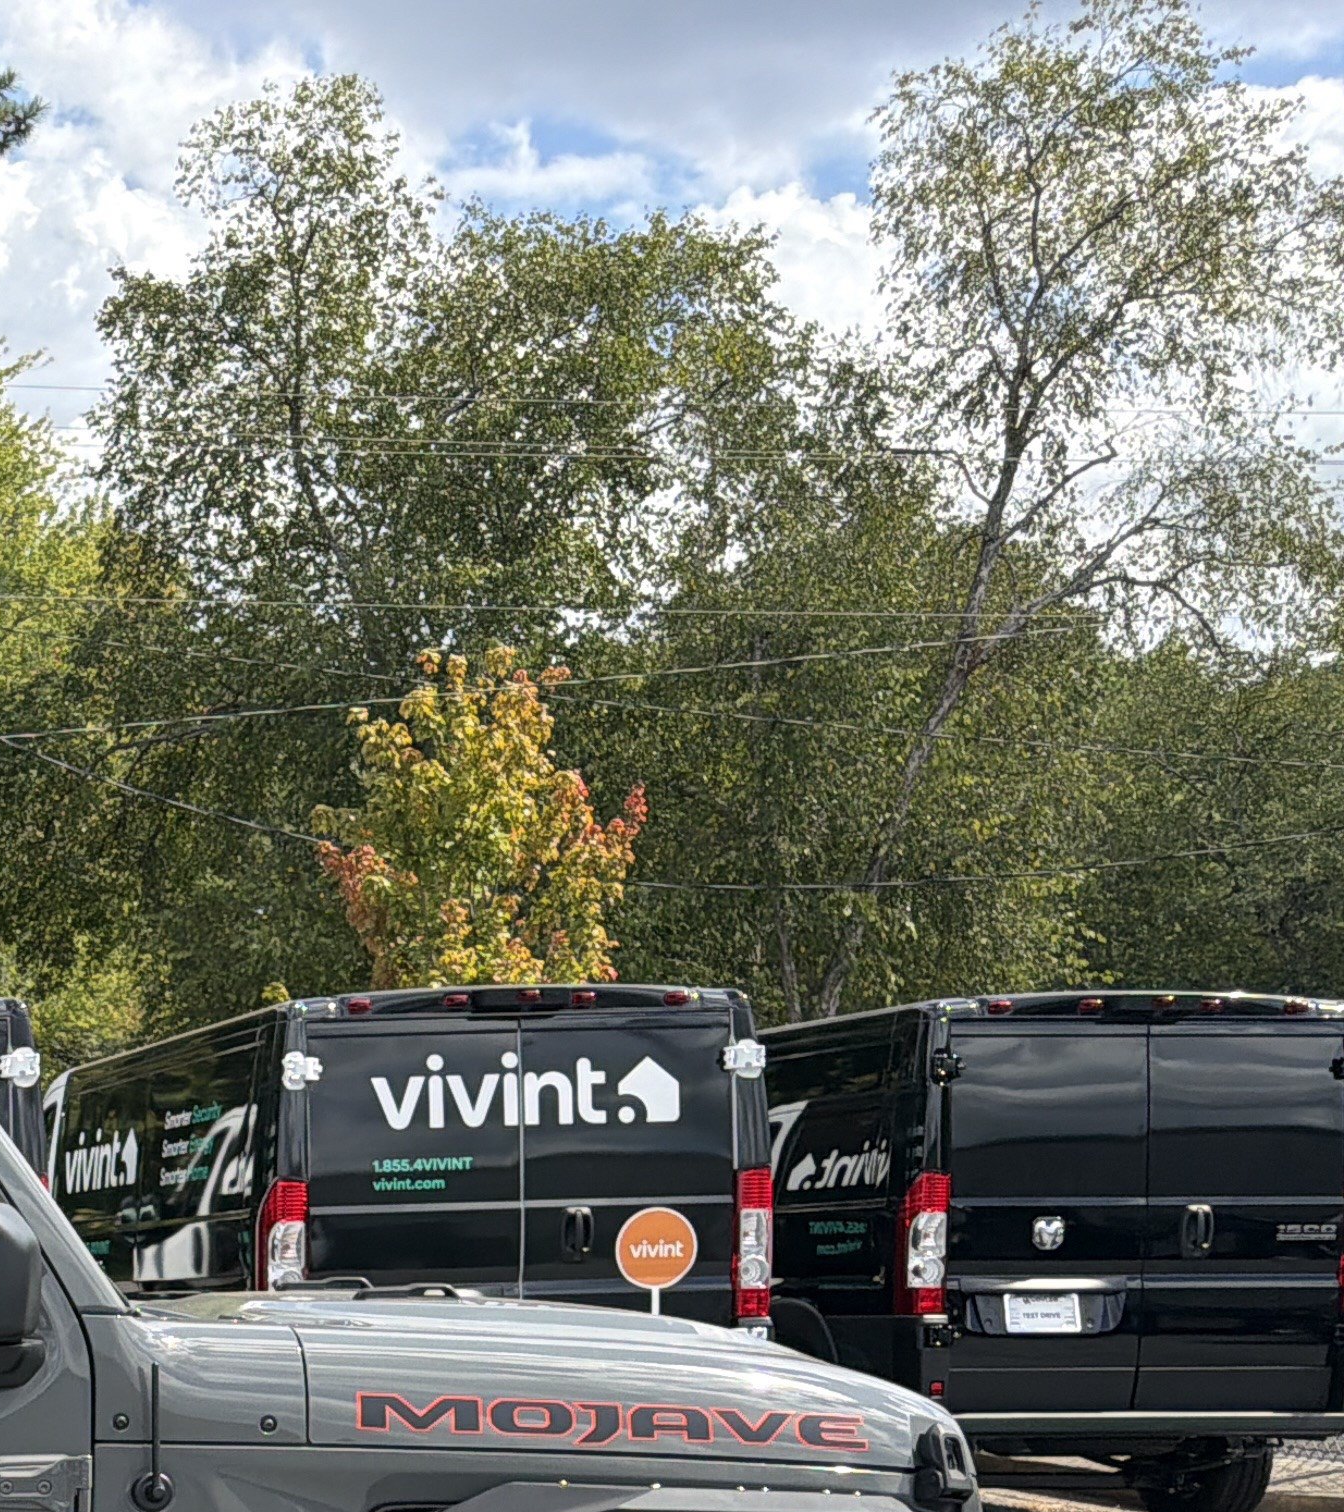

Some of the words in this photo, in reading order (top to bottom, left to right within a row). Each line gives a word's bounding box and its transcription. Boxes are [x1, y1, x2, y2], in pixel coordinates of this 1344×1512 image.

[372, 1156, 474, 1174] 1.855.4VIVINT
[372, 1178, 447, 1192] vivint.com
[629, 1238, 686, 1259] vivint
[355, 1390, 870, 1452] MOJAVE
